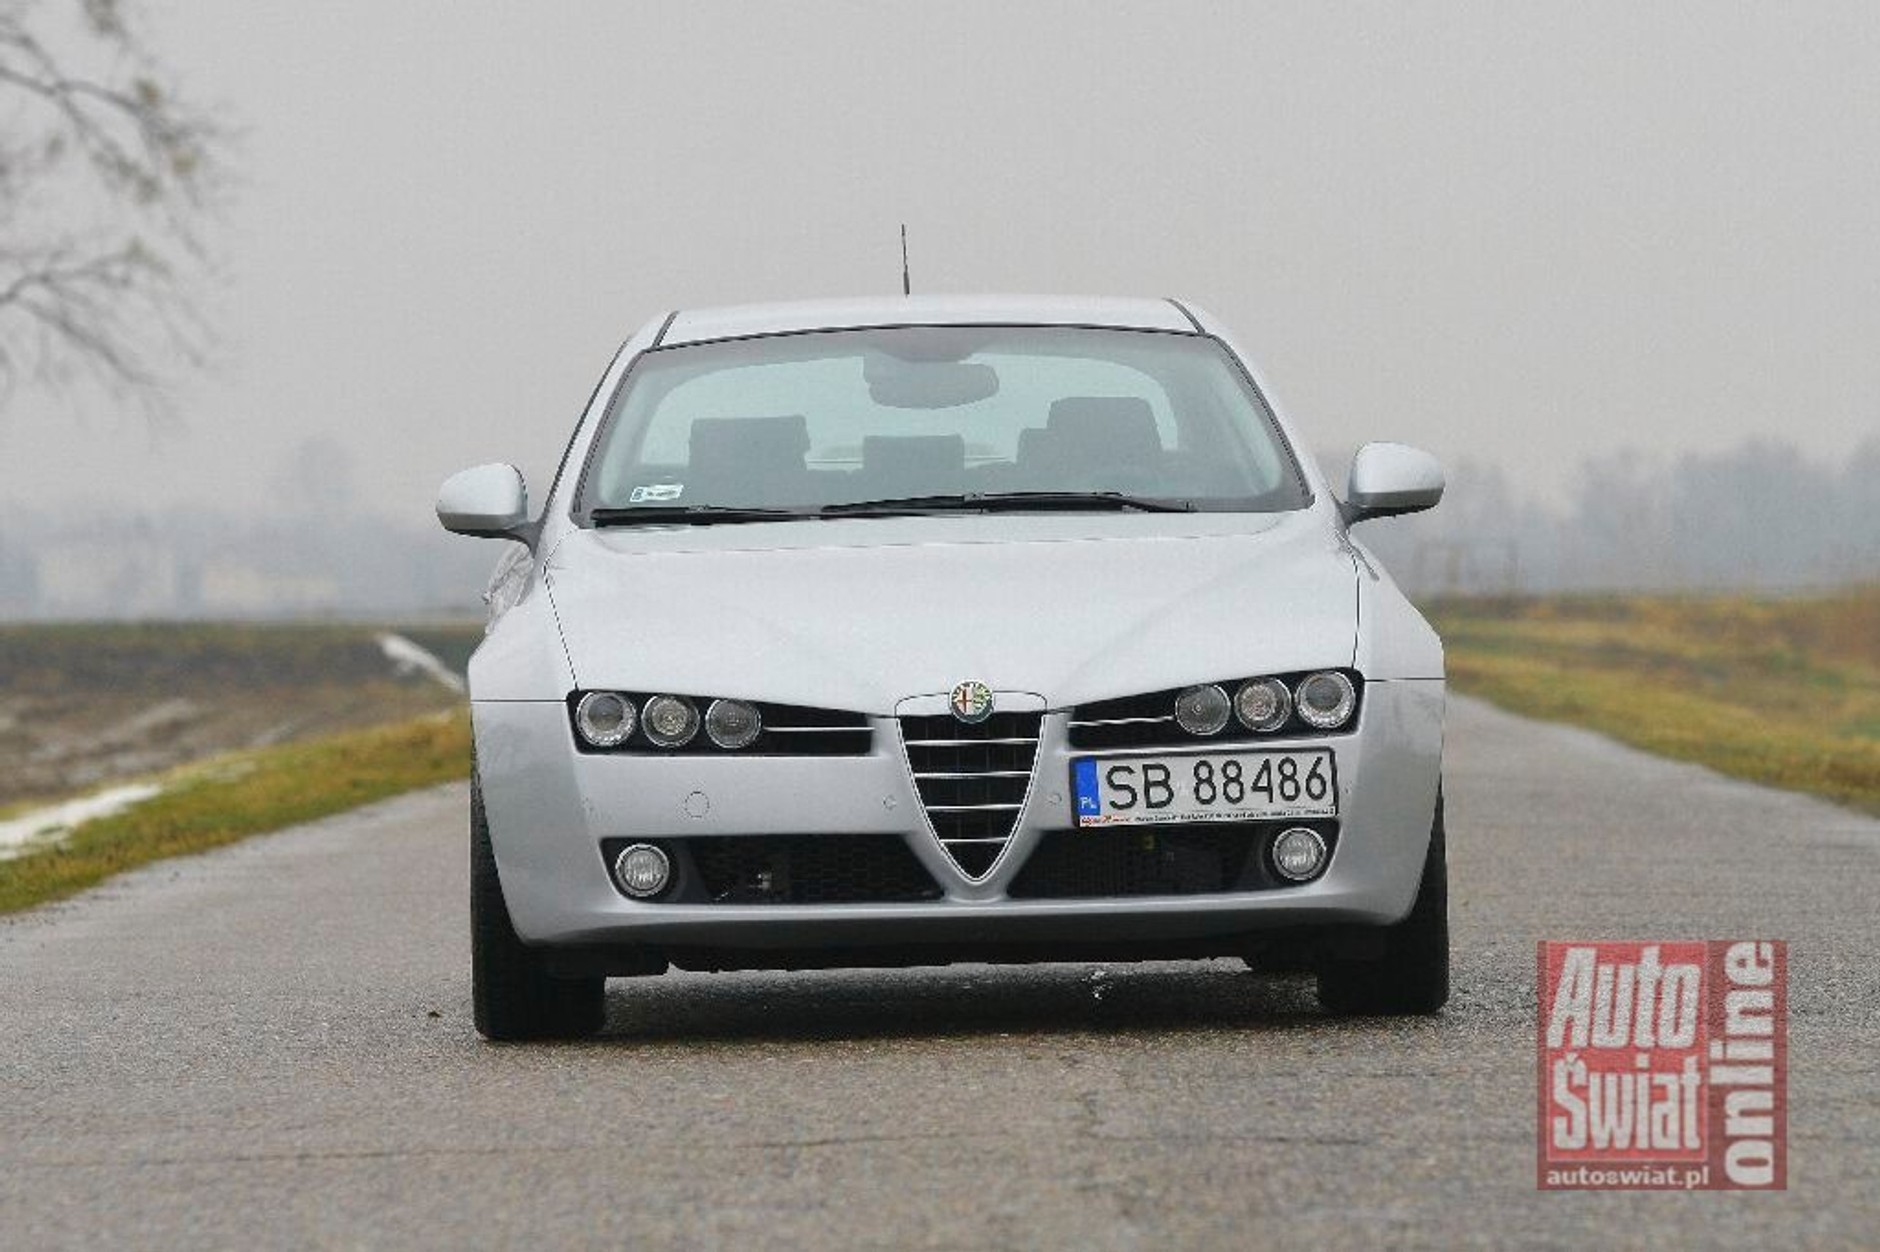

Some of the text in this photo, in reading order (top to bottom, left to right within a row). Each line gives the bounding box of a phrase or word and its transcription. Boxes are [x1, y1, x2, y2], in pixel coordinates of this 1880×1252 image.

[1106, 756, 1328, 810] SB 88486
[1080, 796, 1098, 810] PL
